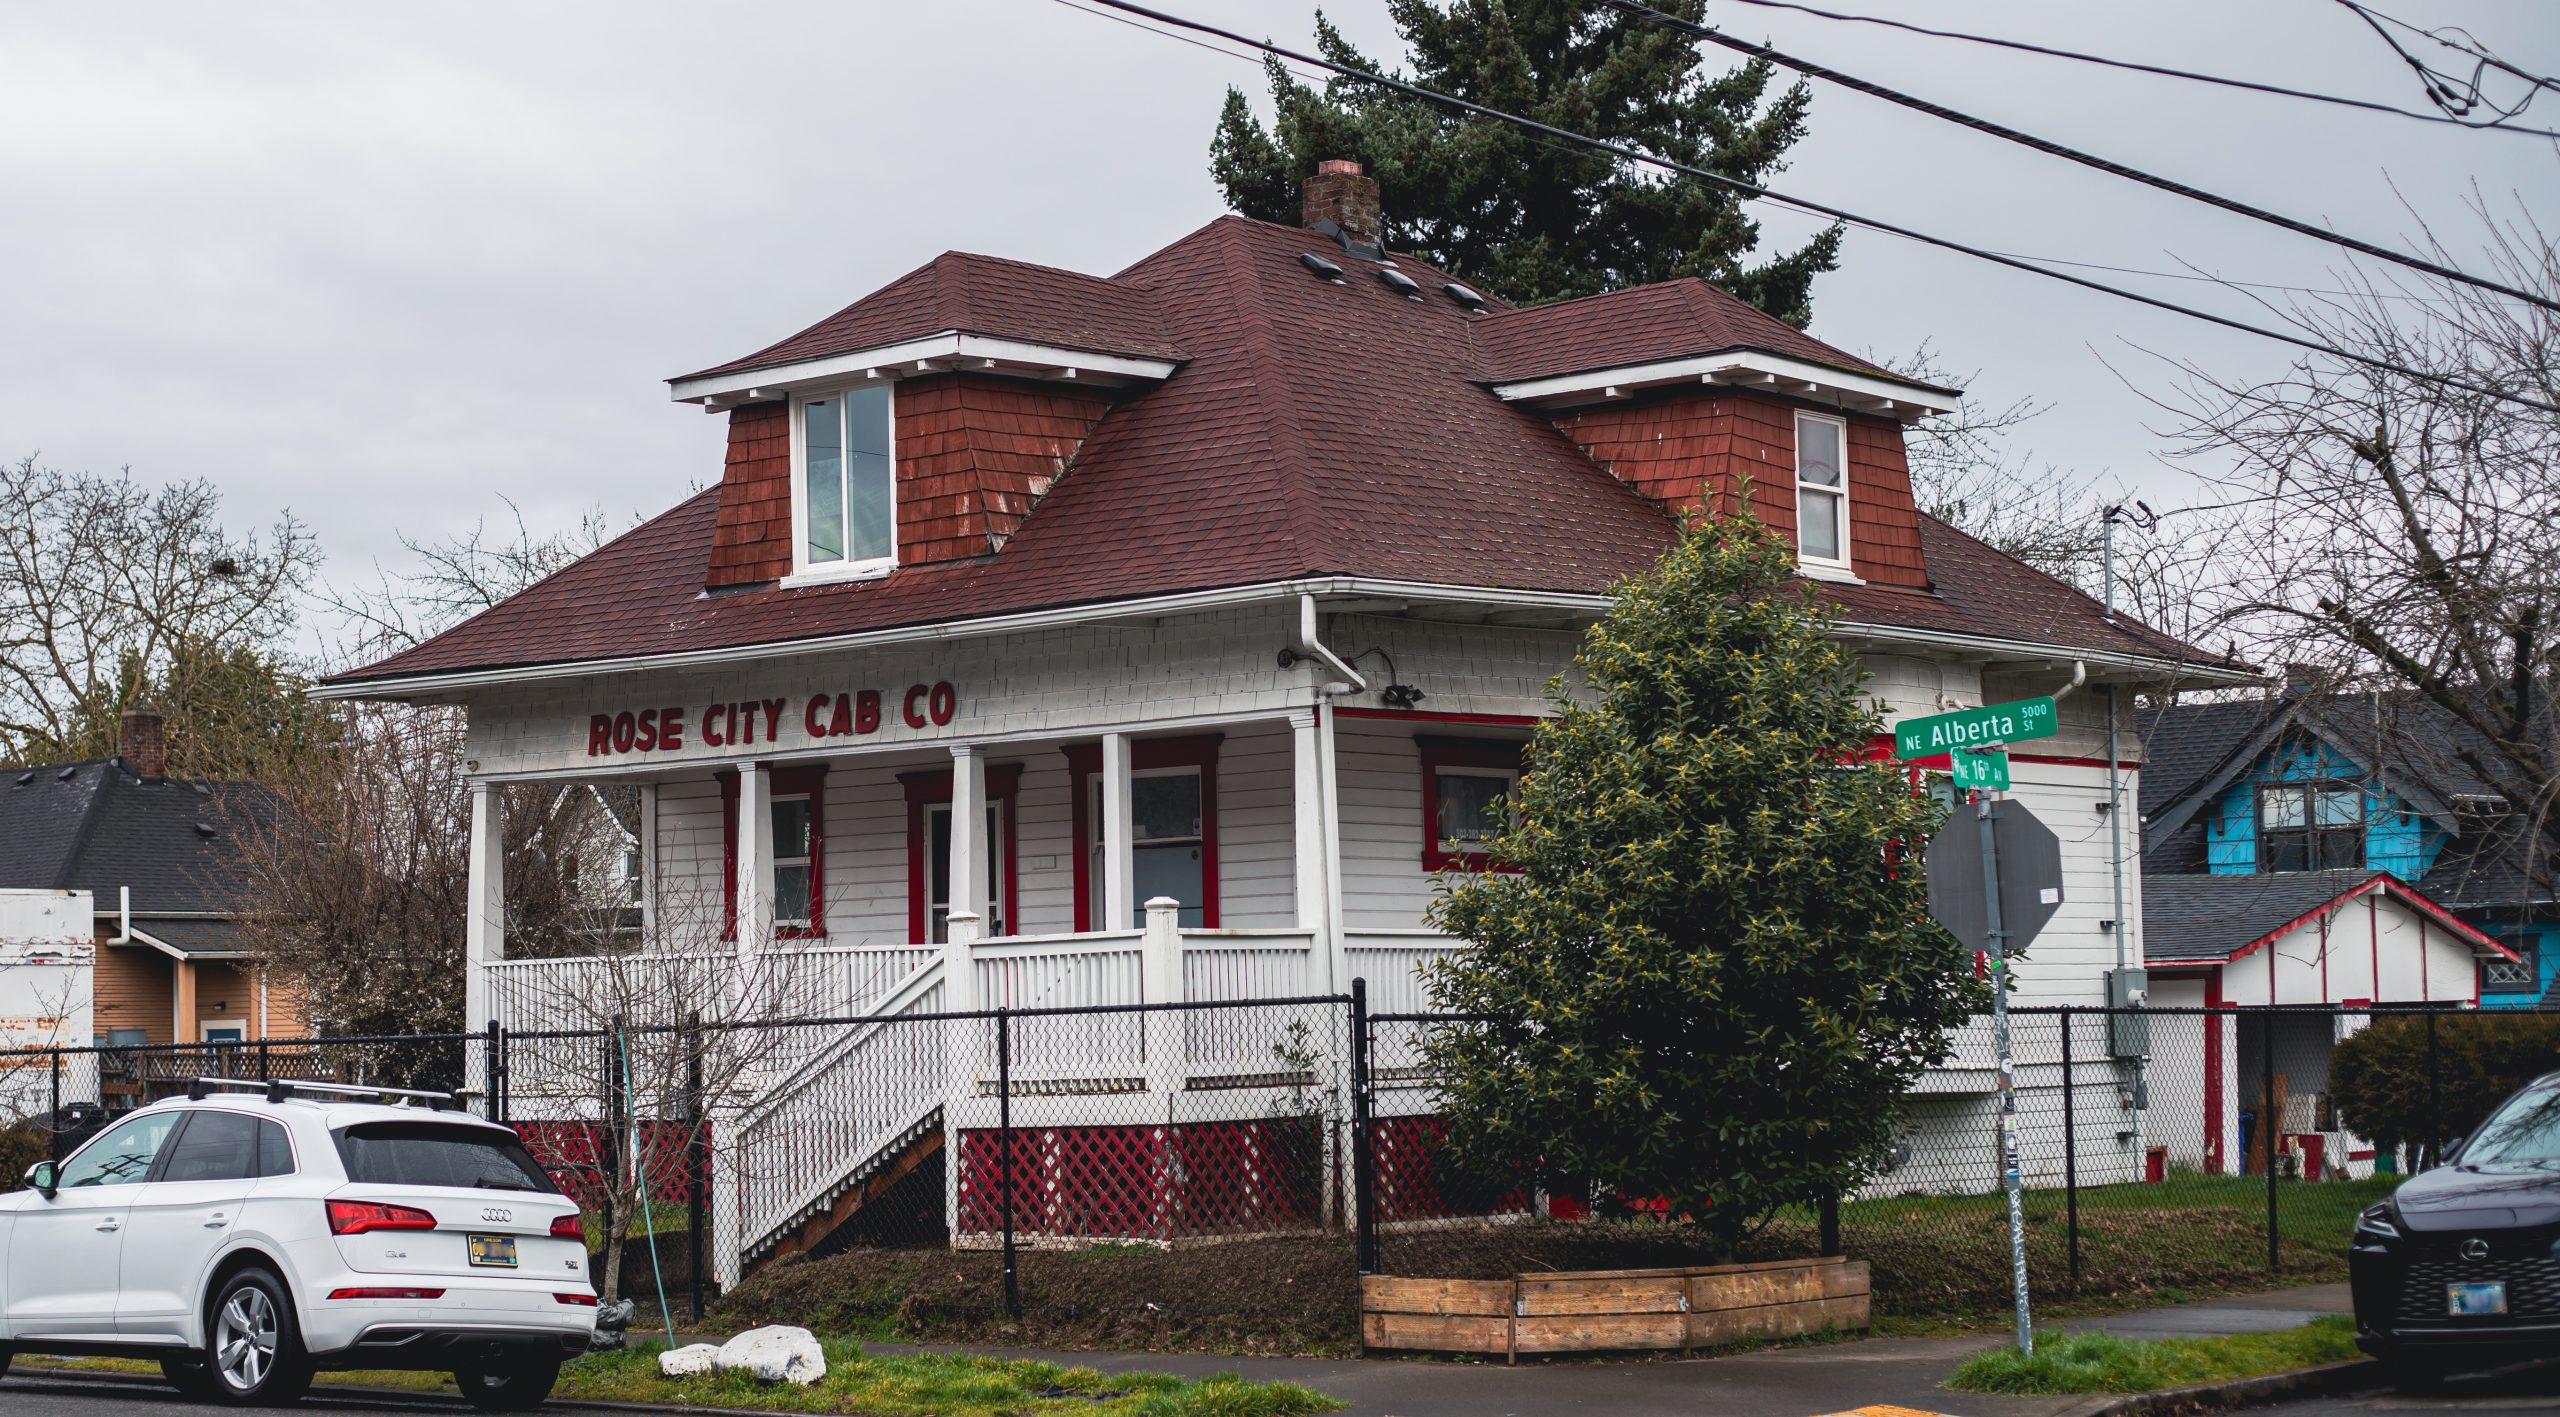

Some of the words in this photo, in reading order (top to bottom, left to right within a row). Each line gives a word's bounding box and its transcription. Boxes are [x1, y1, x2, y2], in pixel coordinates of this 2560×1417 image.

[588, 707, 684, 757] ROSE
[702, 698, 785, 747] CITY
[805, 689, 882, 738] CAB
[903, 681, 955, 729] CO
[2021, 703, 2047, 719] 5000
[1905, 735, 1922, 751] NE
[1931, 715, 2014, 747] Alberta
[2023, 719, 2034, 732] St
[1959, 764, 1969, 780] NE
[1994, 767, 2003, 782] Av
